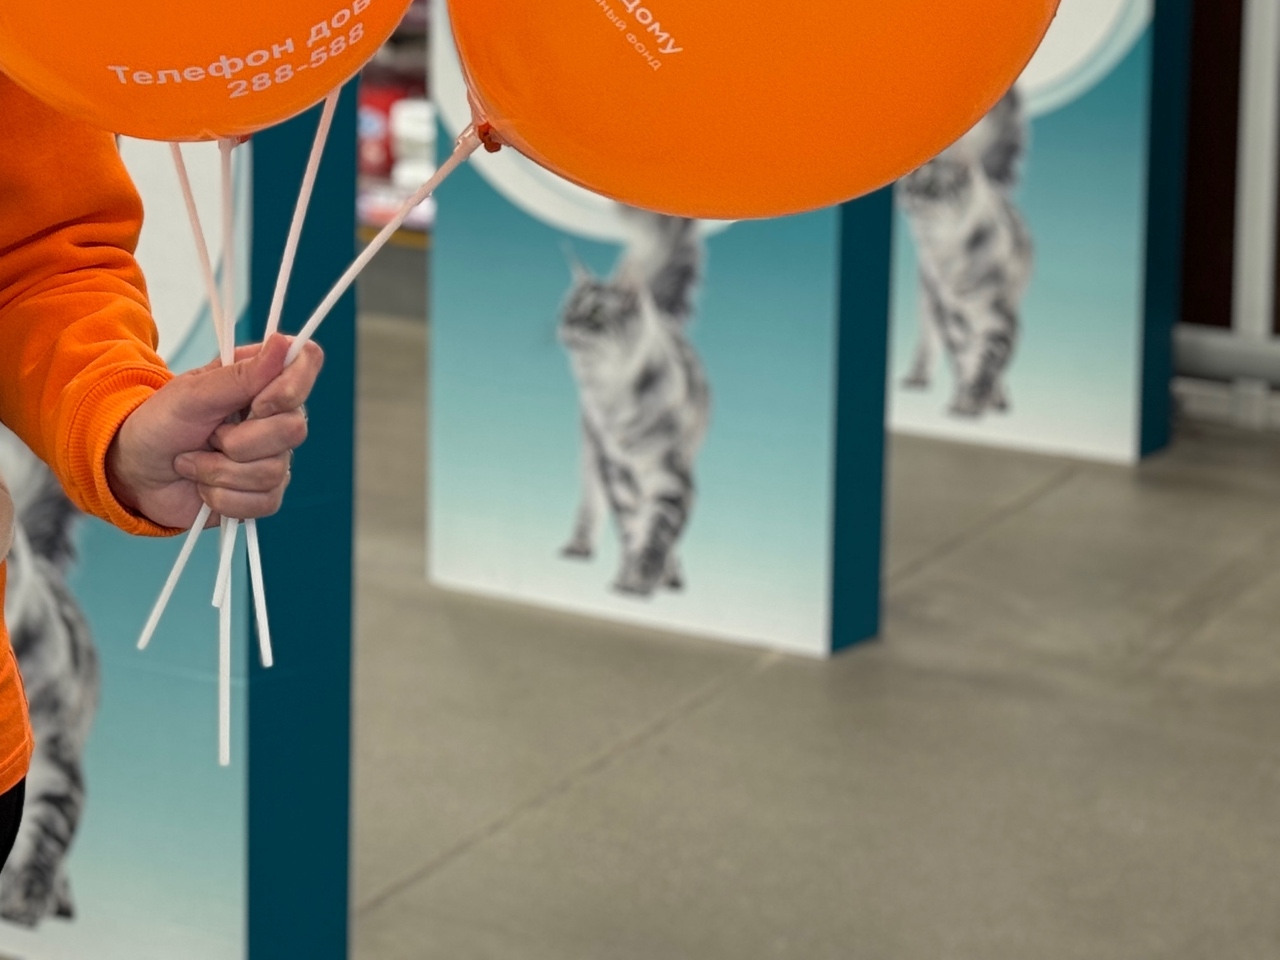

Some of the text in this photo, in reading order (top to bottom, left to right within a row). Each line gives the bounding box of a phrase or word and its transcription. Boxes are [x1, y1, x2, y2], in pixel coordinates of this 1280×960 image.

[108, 38, 295, 84] Телефон
[227, 22, 365, 98] 288-588
[626, 33, 662, 71] ФОНД
